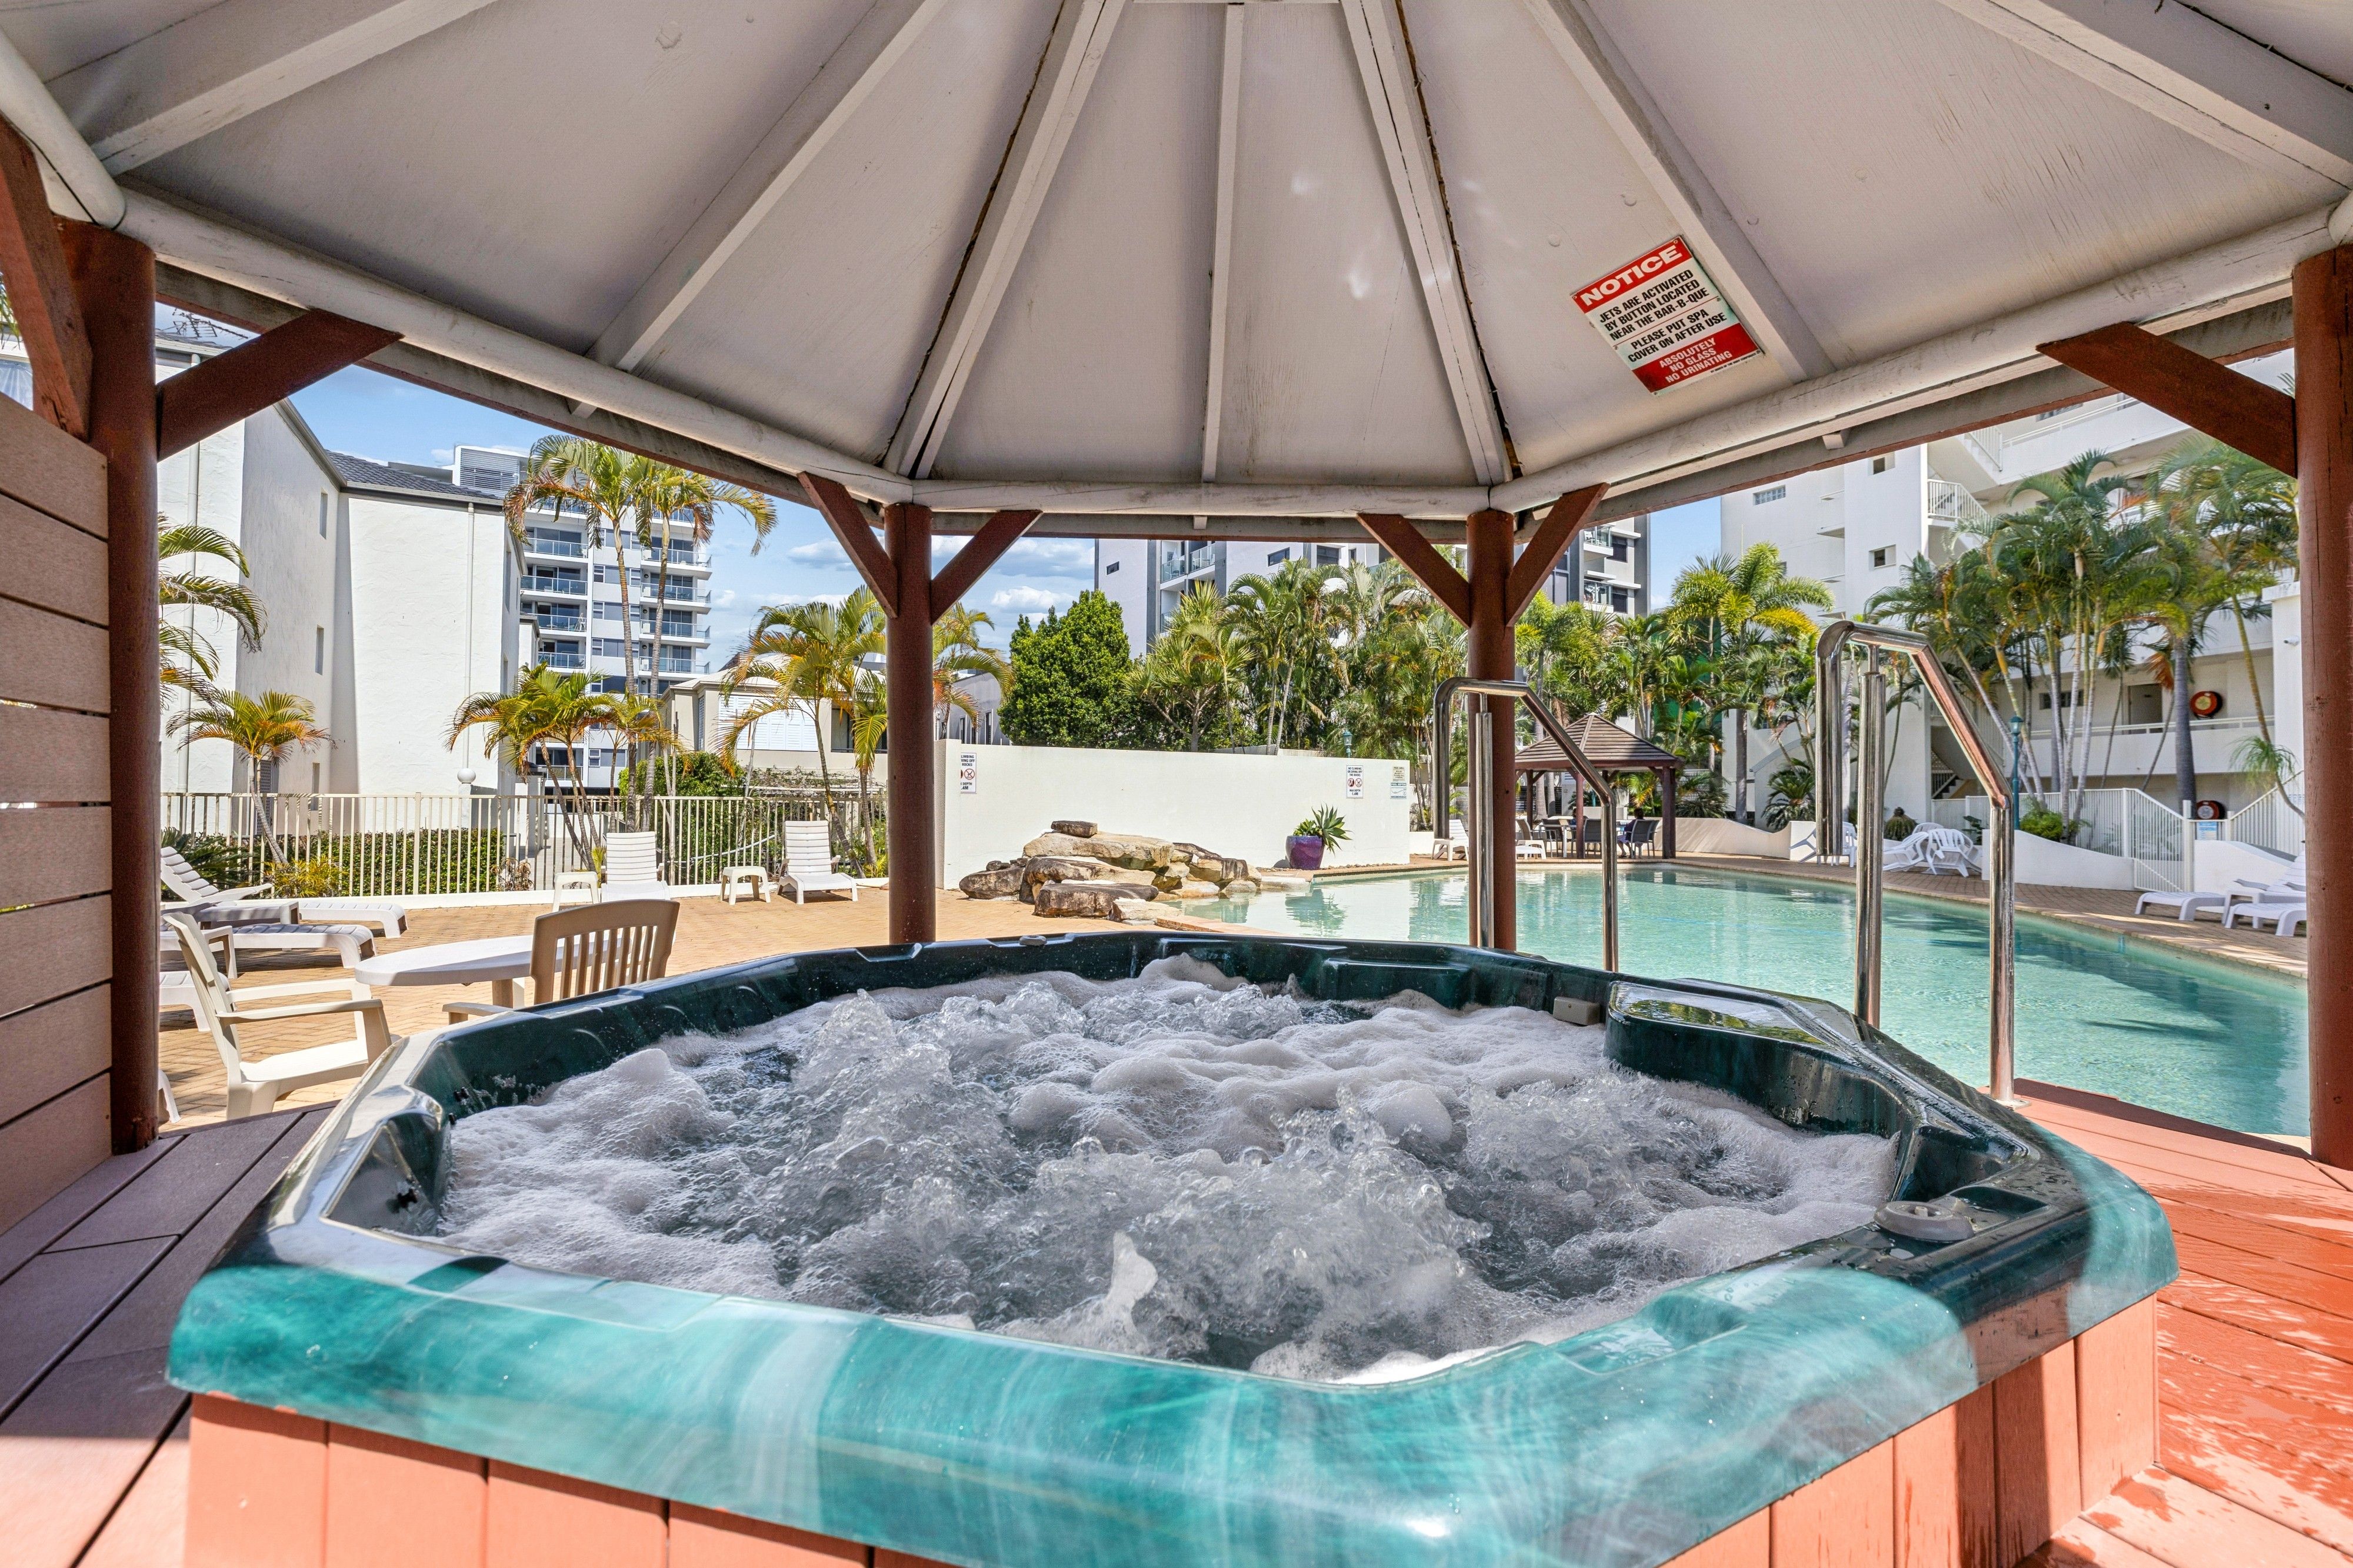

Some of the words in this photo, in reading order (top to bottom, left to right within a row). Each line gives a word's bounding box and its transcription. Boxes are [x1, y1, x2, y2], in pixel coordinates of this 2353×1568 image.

[1581, 245, 1682, 306] NOTICE
[1599, 305, 1622, 323] JETS
[1623, 295, 1642, 312] ARE
[1642, 269, 1694, 303] ACTIVATED
[1604, 319, 1618, 332] BY
[1619, 302, 1657, 324] BUTTON
[1657, 279, 1700, 308] LOCATED
[1609, 323, 1636, 341] NEAR
[1637, 314, 1655, 329] THE
[1656, 288, 1709, 320] BAR-B-QUE
[1631, 328, 1667, 349] PLEASE
[1667, 319, 1687, 333] PUT
[1689, 309, 1709, 323] SPA
[1628, 343, 1660, 362] COVER
[1661, 338, 1675, 349] ON
[1676, 323, 1707, 342] AFTER
[1707, 312, 1727, 328] USE
[1659, 338, 1716, 368] ABSOLUTELY
[1669, 361, 1685, 372] NO
[1687, 348, 1717, 365] GLASS
[1665, 371, 1681, 383] NO
[1682, 351, 1732, 376] URINATING
